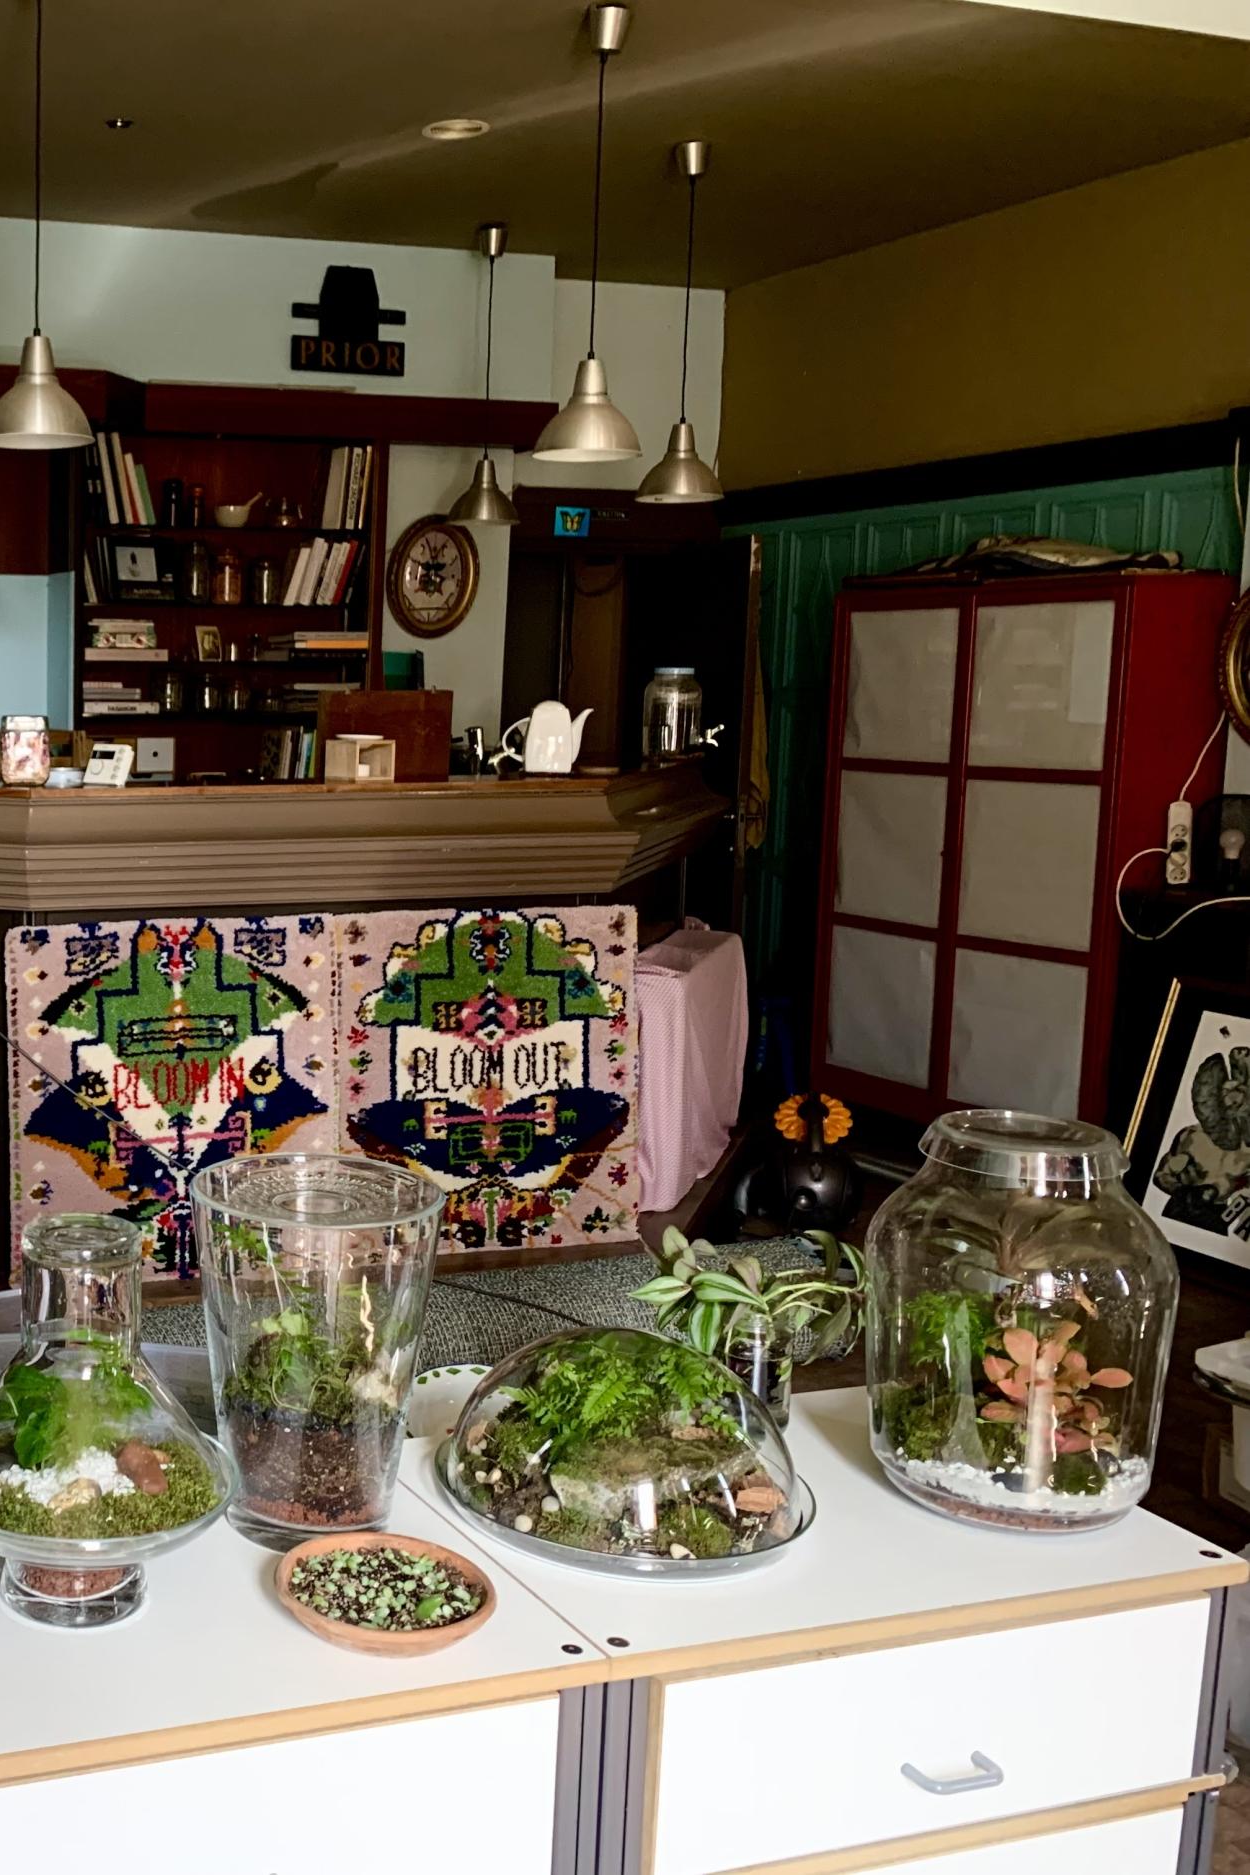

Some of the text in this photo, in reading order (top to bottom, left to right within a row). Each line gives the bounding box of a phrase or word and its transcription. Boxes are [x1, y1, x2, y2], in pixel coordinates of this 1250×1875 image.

[300, 338, 401, 371] PRIOR
[113, 1056, 245, 1112] BLOOM IN
[412, 1041, 566, 1094] BLOOM OUT
